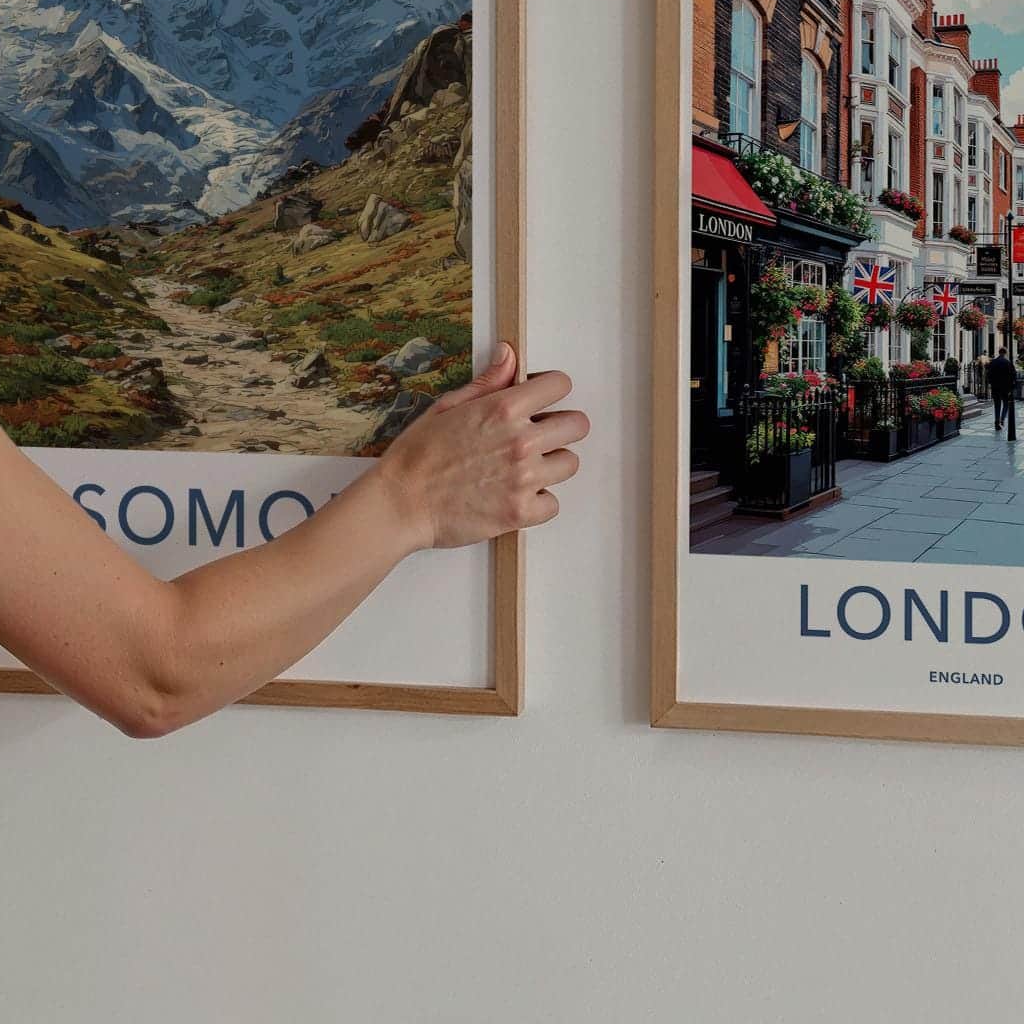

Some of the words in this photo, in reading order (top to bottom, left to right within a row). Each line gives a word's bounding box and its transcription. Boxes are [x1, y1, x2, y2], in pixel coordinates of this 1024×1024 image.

[699, 214, 753, 242] LONDON
[73, 483, 339, 548] SOMO
[800, 584, 1024, 645] LOND
[929, 671, 1004, 686] ENGLAND
